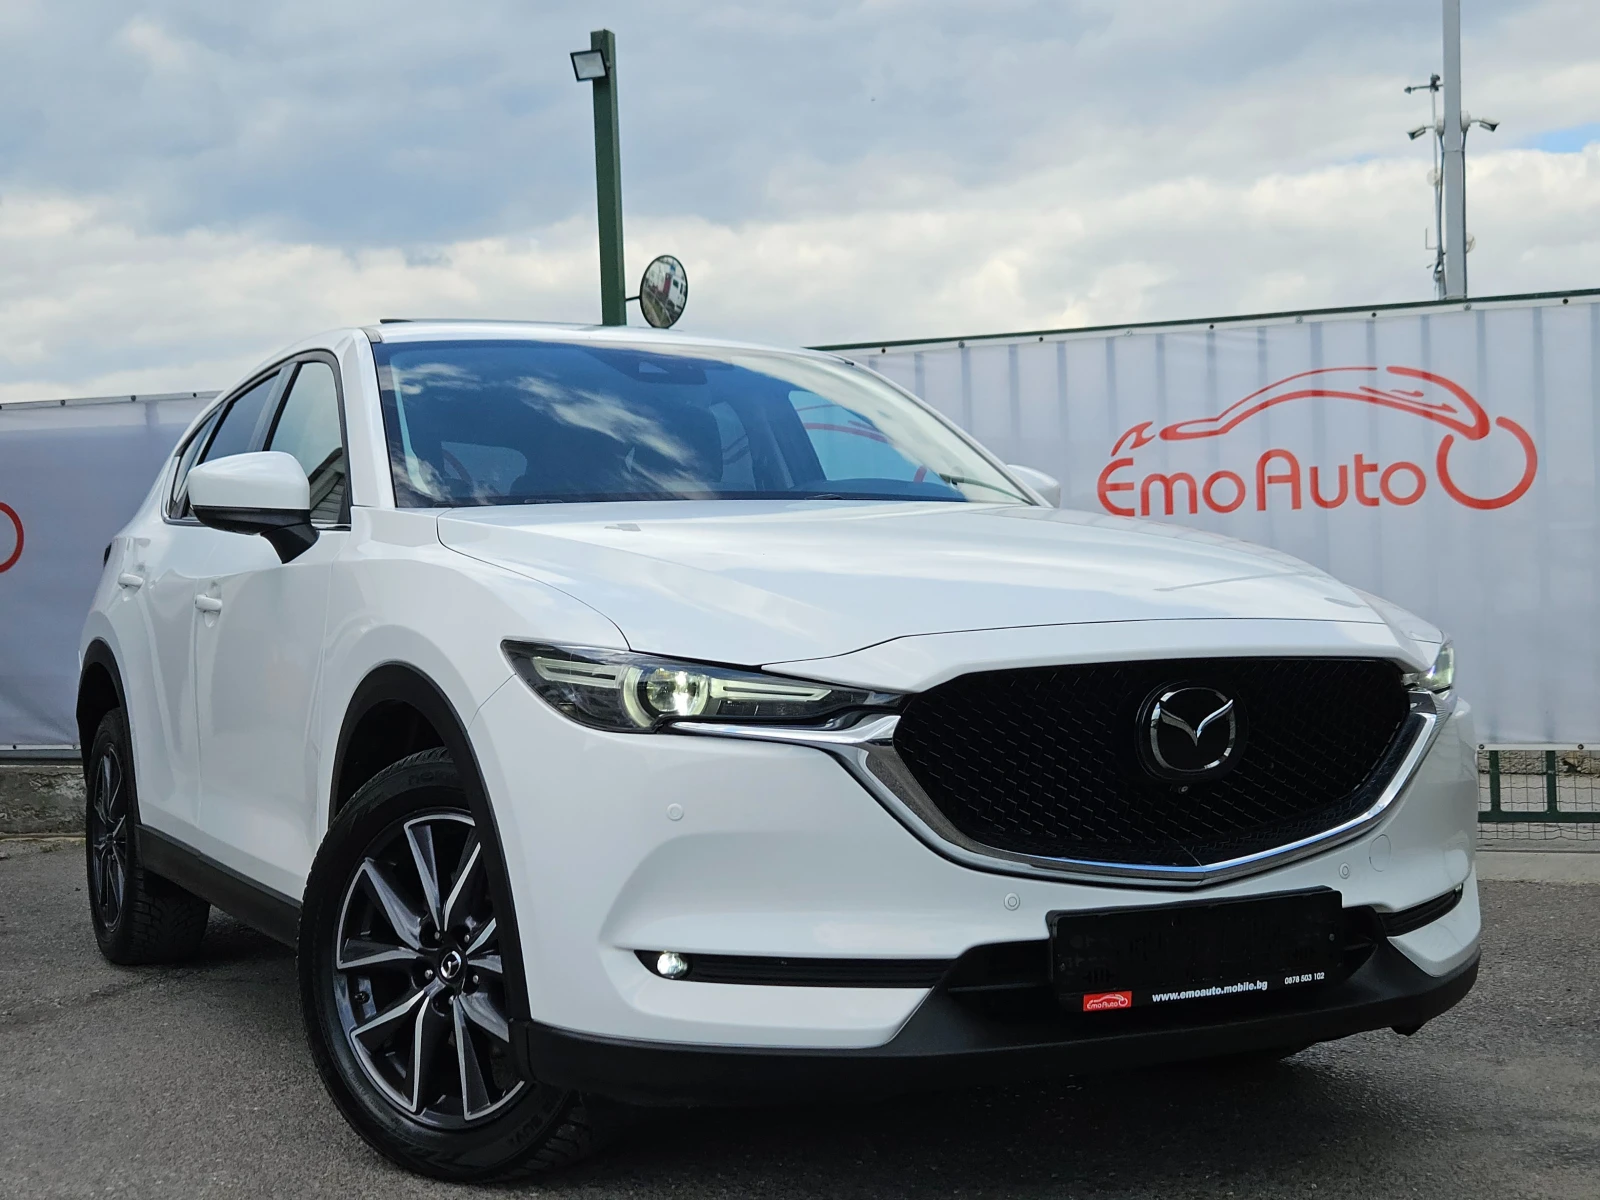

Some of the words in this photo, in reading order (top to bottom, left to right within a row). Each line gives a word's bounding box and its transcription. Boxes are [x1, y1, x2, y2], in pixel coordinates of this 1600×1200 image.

[1097, 448, 1427, 517] EmoAuto
[1314, 971, 1325, 981] 102
[1152, 980, 1268, 1002] www.emoauto.mobile.bg
